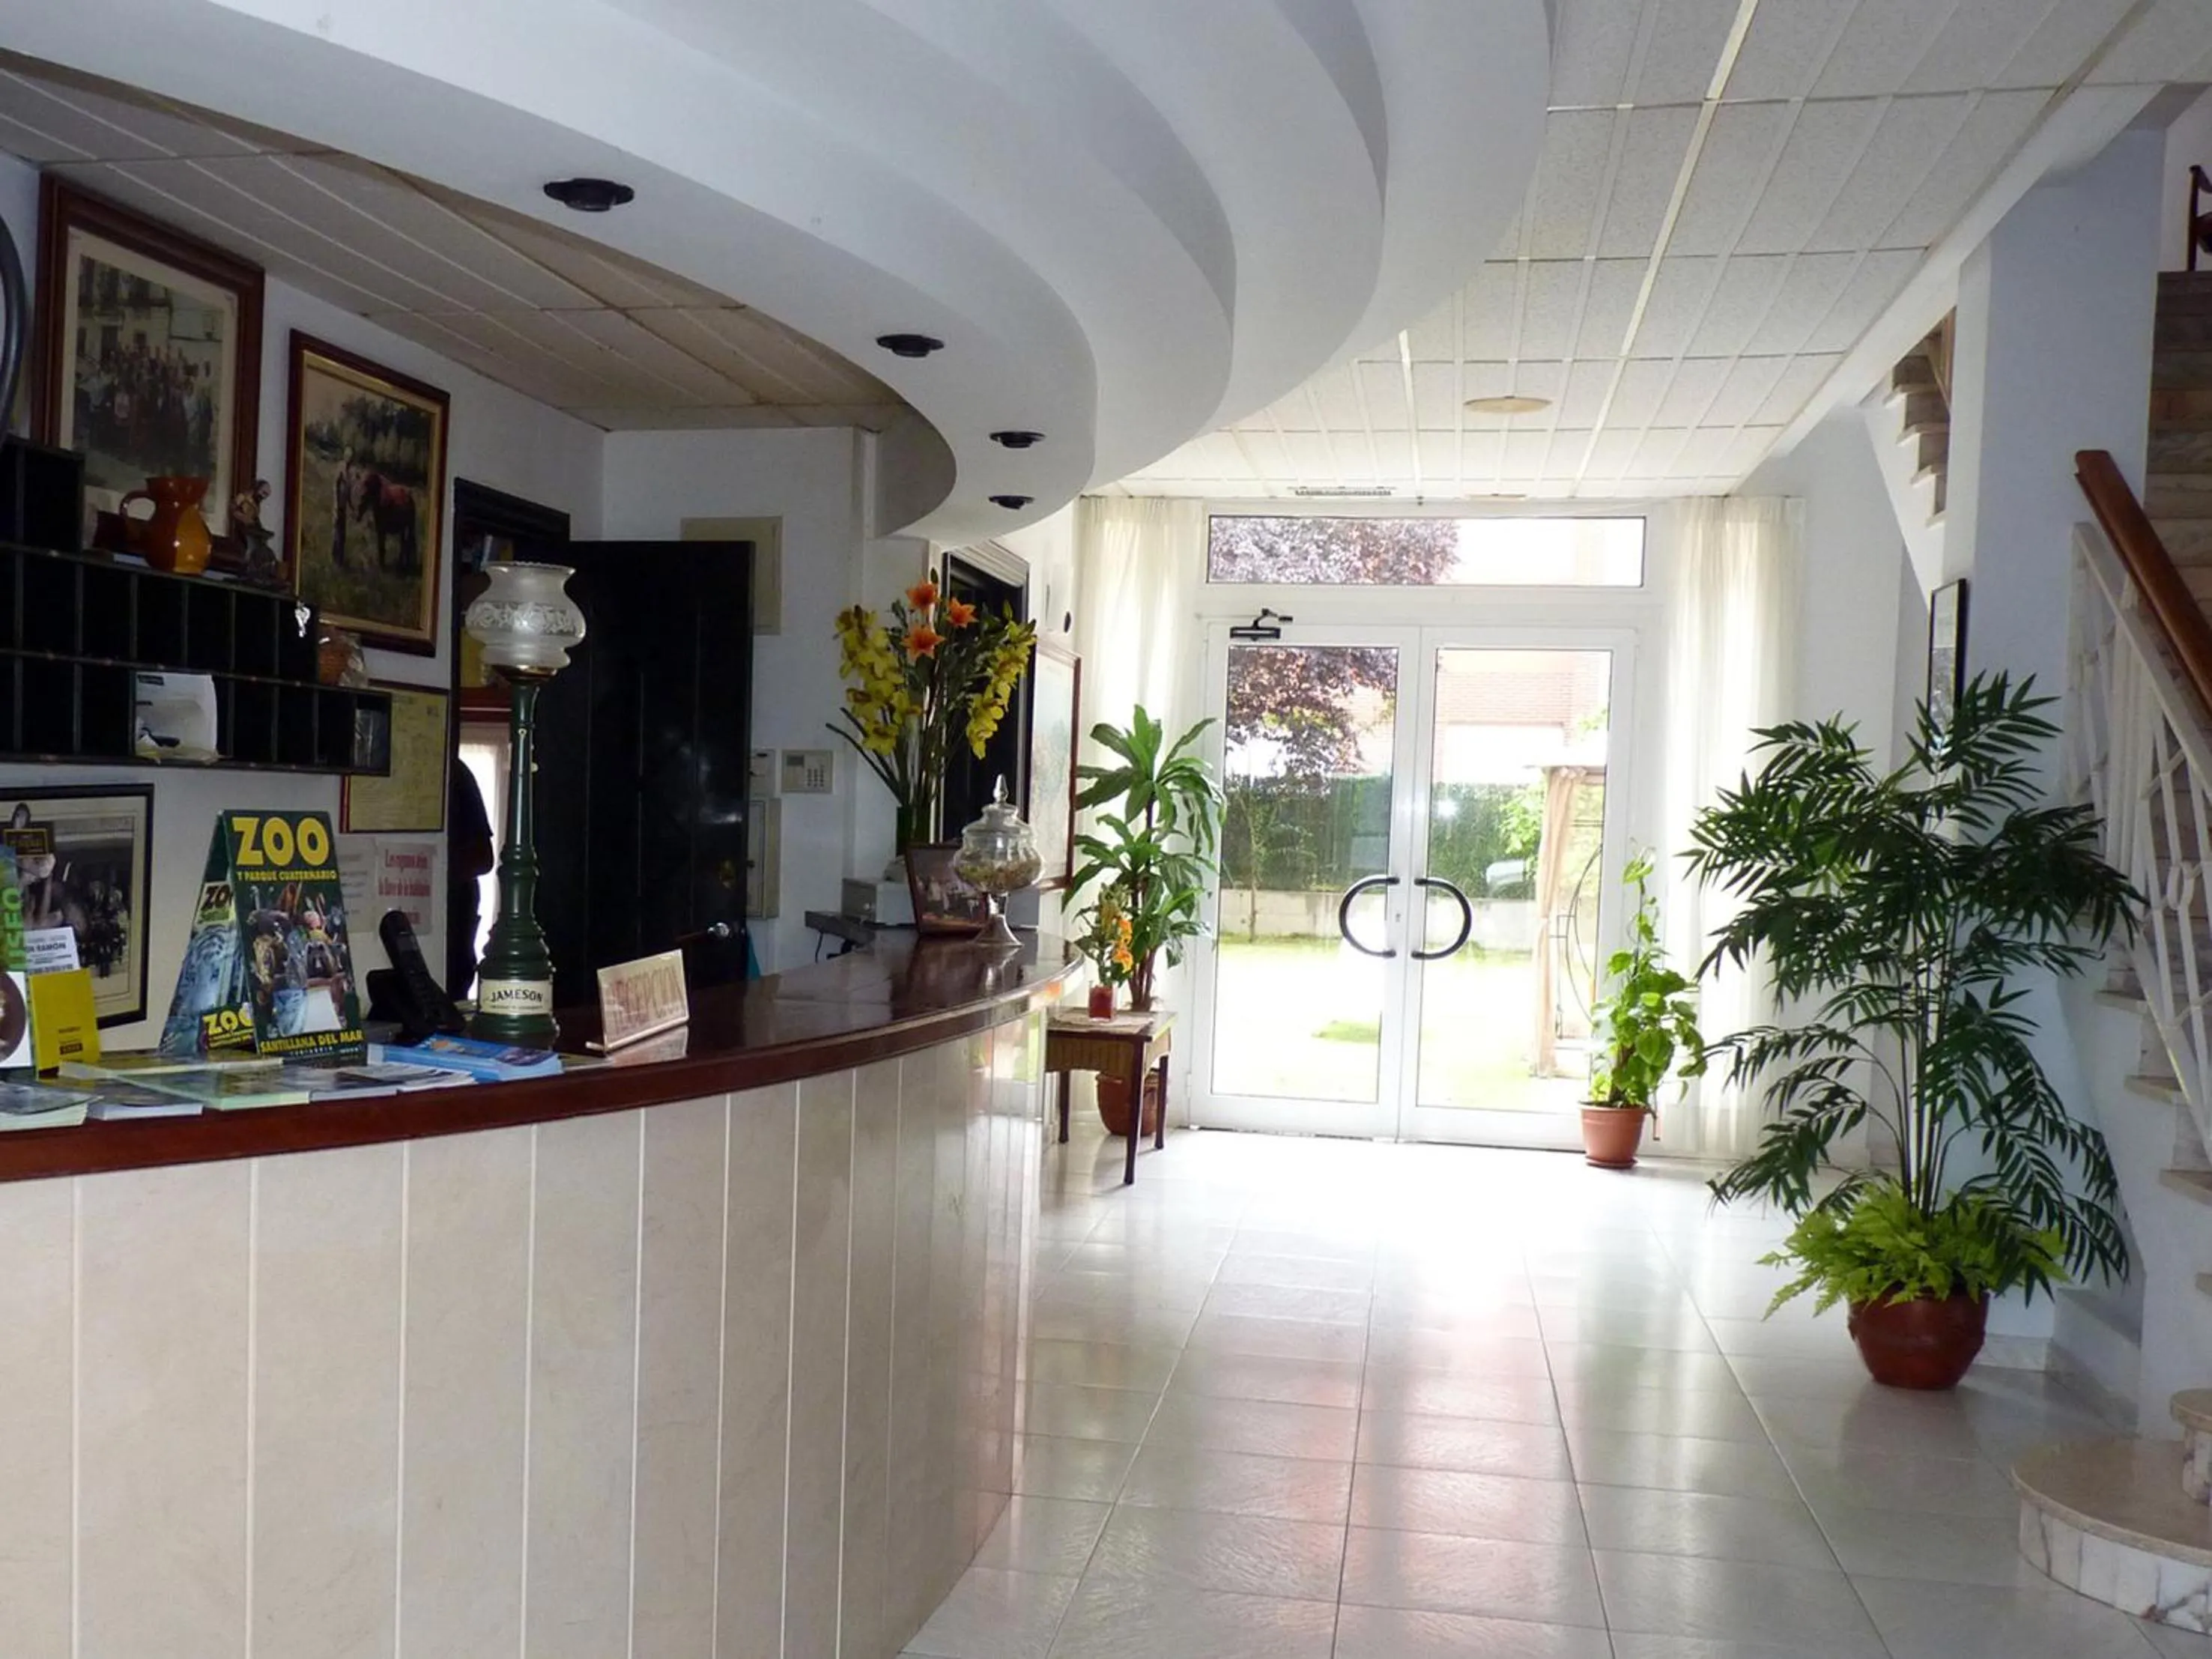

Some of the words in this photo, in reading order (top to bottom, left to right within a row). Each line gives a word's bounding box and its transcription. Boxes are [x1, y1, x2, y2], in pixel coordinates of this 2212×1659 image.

[231, 816, 330, 867] ZOO
[200, 885, 232, 911] ZO
[2, 887, 27, 970] USEO
[491, 989, 543, 1002] JAMESON
[260, 1036, 317, 1053] SANTILLANA
[318, 1033, 339, 1046] DEL
[340, 1029, 364, 1043] MAR
